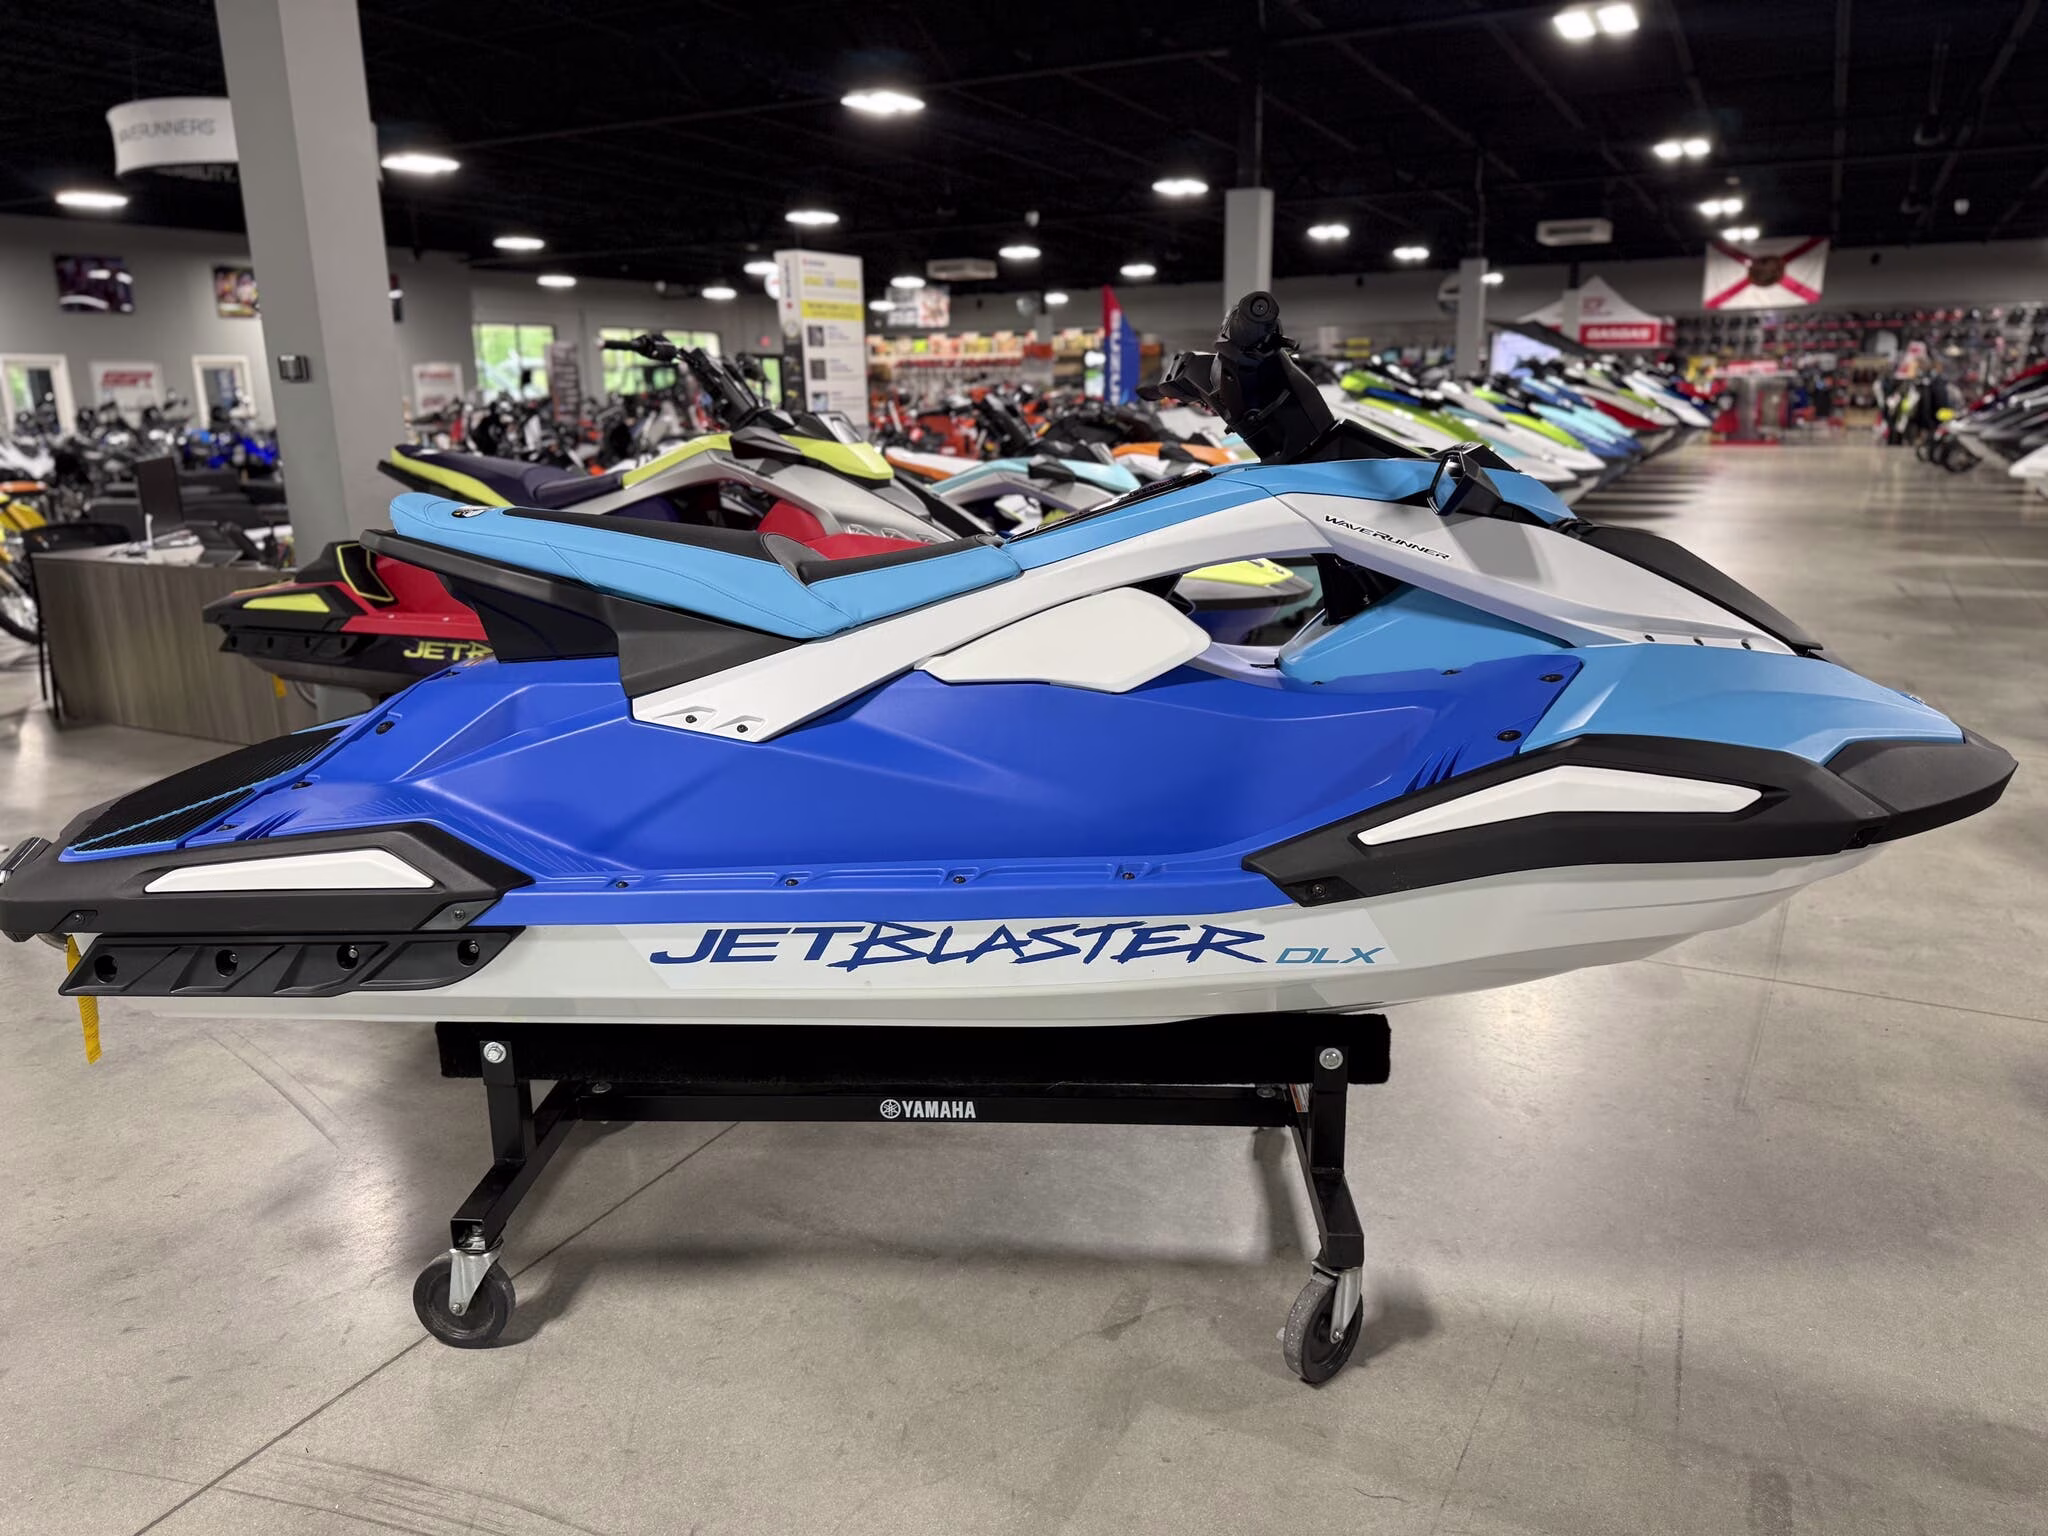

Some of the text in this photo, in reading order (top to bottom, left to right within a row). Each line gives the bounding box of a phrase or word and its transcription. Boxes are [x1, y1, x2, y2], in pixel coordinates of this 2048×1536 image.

[1325, 515, 1450, 559] WAVERUNNER
[1276, 947, 1385, 964] DLX
[902, 1101, 976, 1119] YAMAHA
